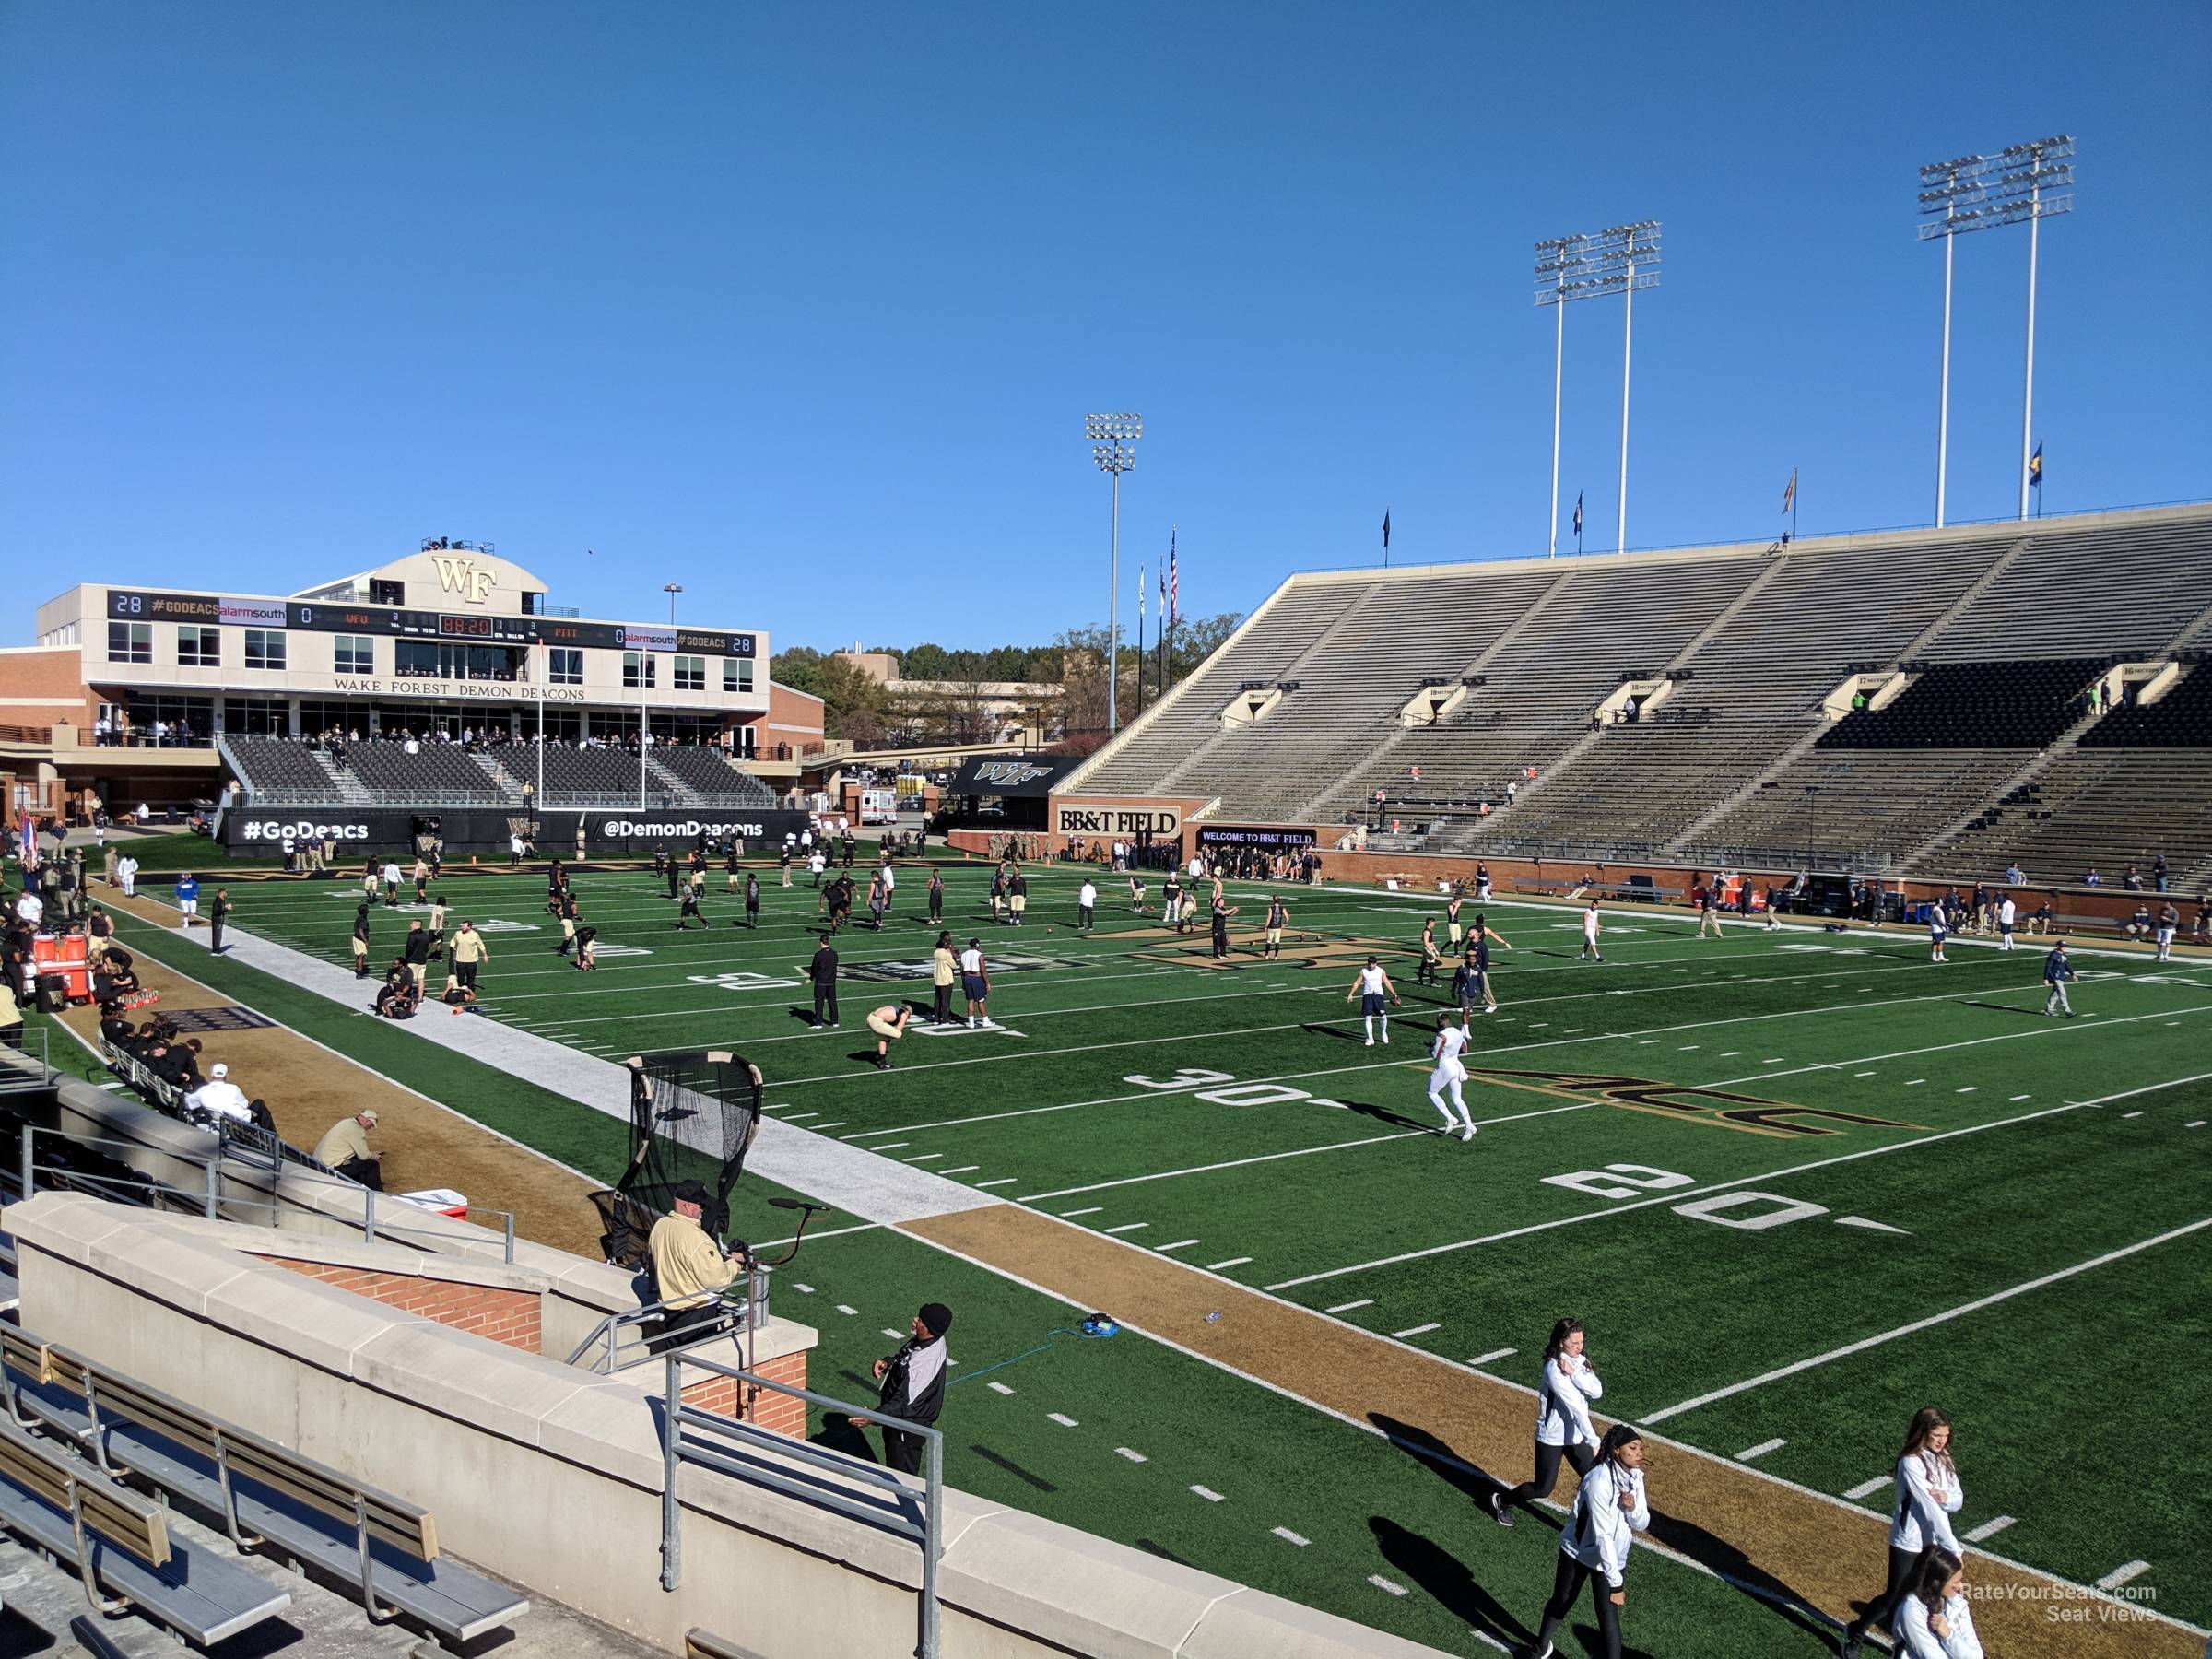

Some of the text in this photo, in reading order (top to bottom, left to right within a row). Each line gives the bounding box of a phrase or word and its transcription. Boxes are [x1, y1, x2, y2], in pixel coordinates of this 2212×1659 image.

[433, 557, 497, 604] WF
[117, 595, 142, 613] 28
[151, 599, 219, 616] #GODEACS
[219, 606, 285, 619] alarmsouth
[625, 633, 677, 645] alarmsouth
[677, 636, 726, 649] #GODEACS
[733, 637, 750, 653] 28
[335, 679, 585, 700] WAKE FOREST DEMON DEACONS
[974, 761, 1054, 785] WF
[243, 820, 369, 840] #GoDeacs
[604, 820, 763, 837] @DemonDeacons
[1060, 810, 1176, 834] BB&T FIELD
[1203, 831, 1312, 844] WELCOME TO BB&T FIELD
[1123, 1067, 1313, 1108] 30
[1538, 1162, 1832, 1231] 20
